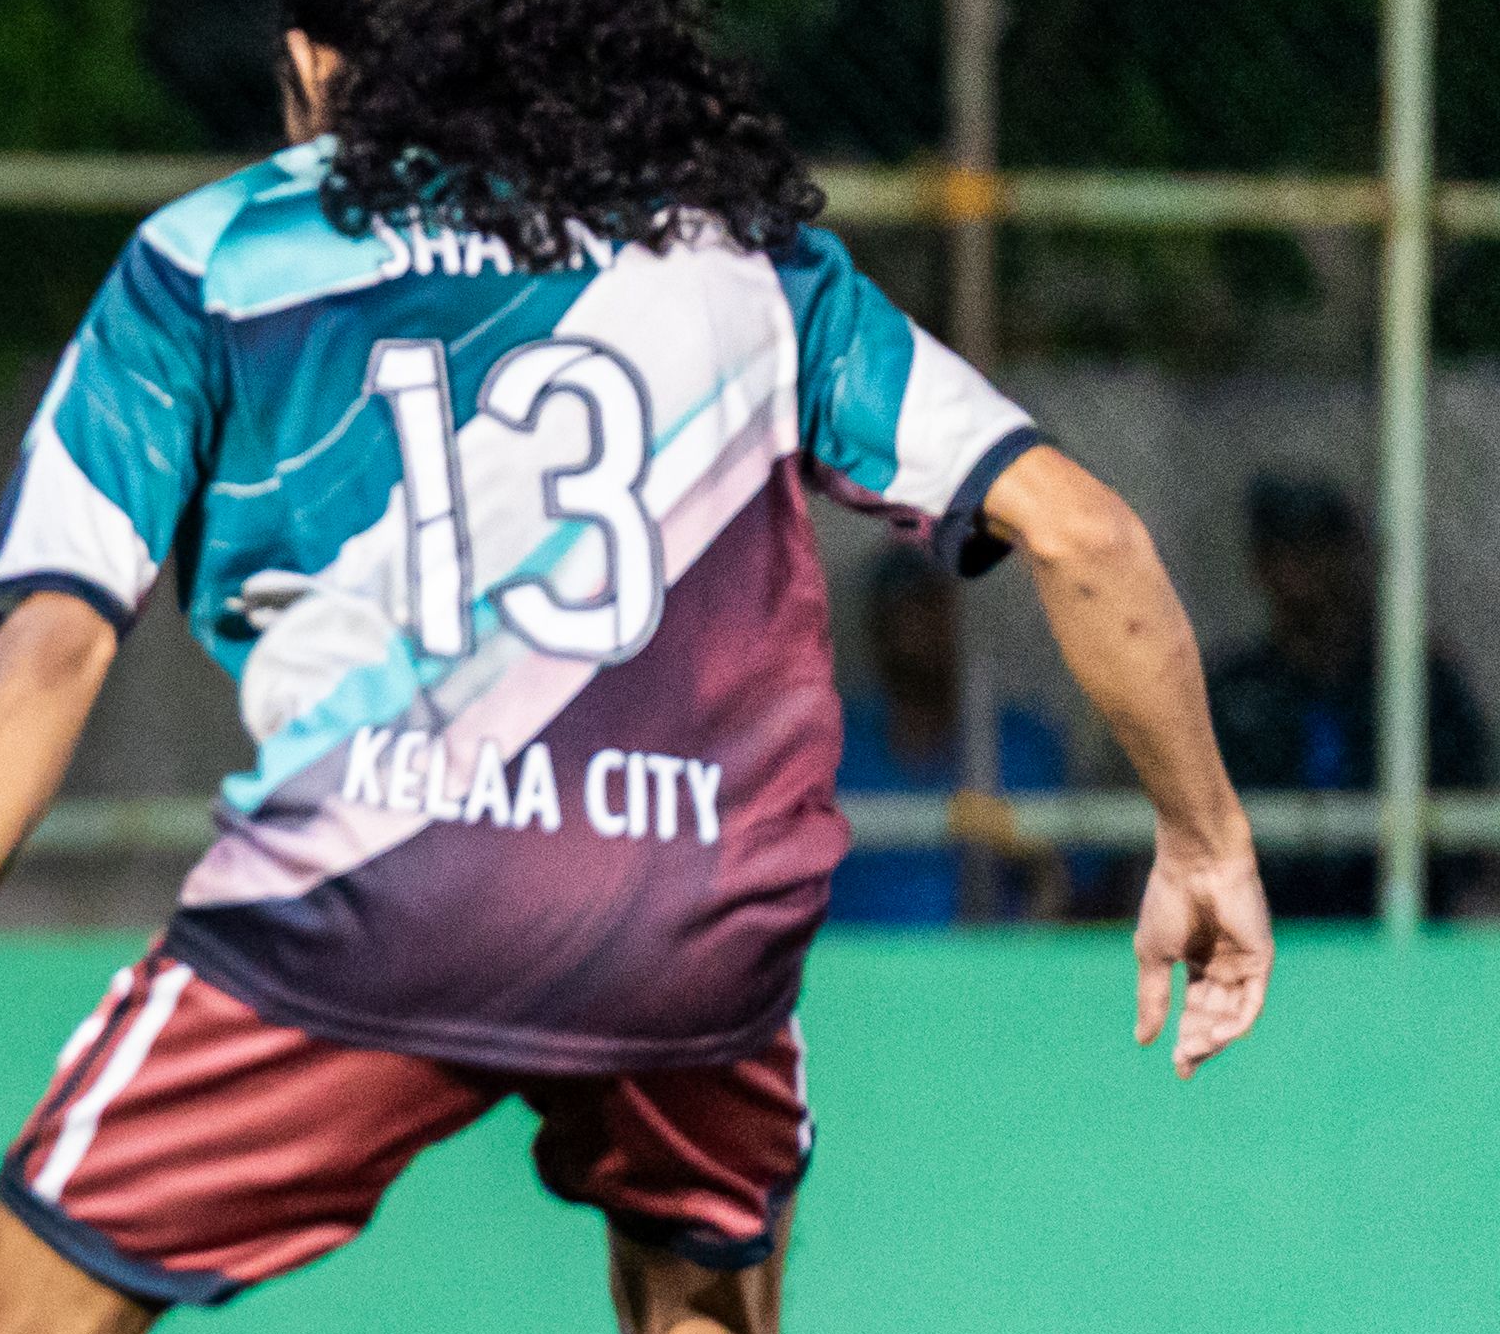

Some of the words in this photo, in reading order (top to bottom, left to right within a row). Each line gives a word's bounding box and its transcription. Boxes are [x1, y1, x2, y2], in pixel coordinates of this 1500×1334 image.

[367, 338, 663, 663] 13
[342, 725, 562, 833] KELAA
[584, 747, 723, 845] CITY
